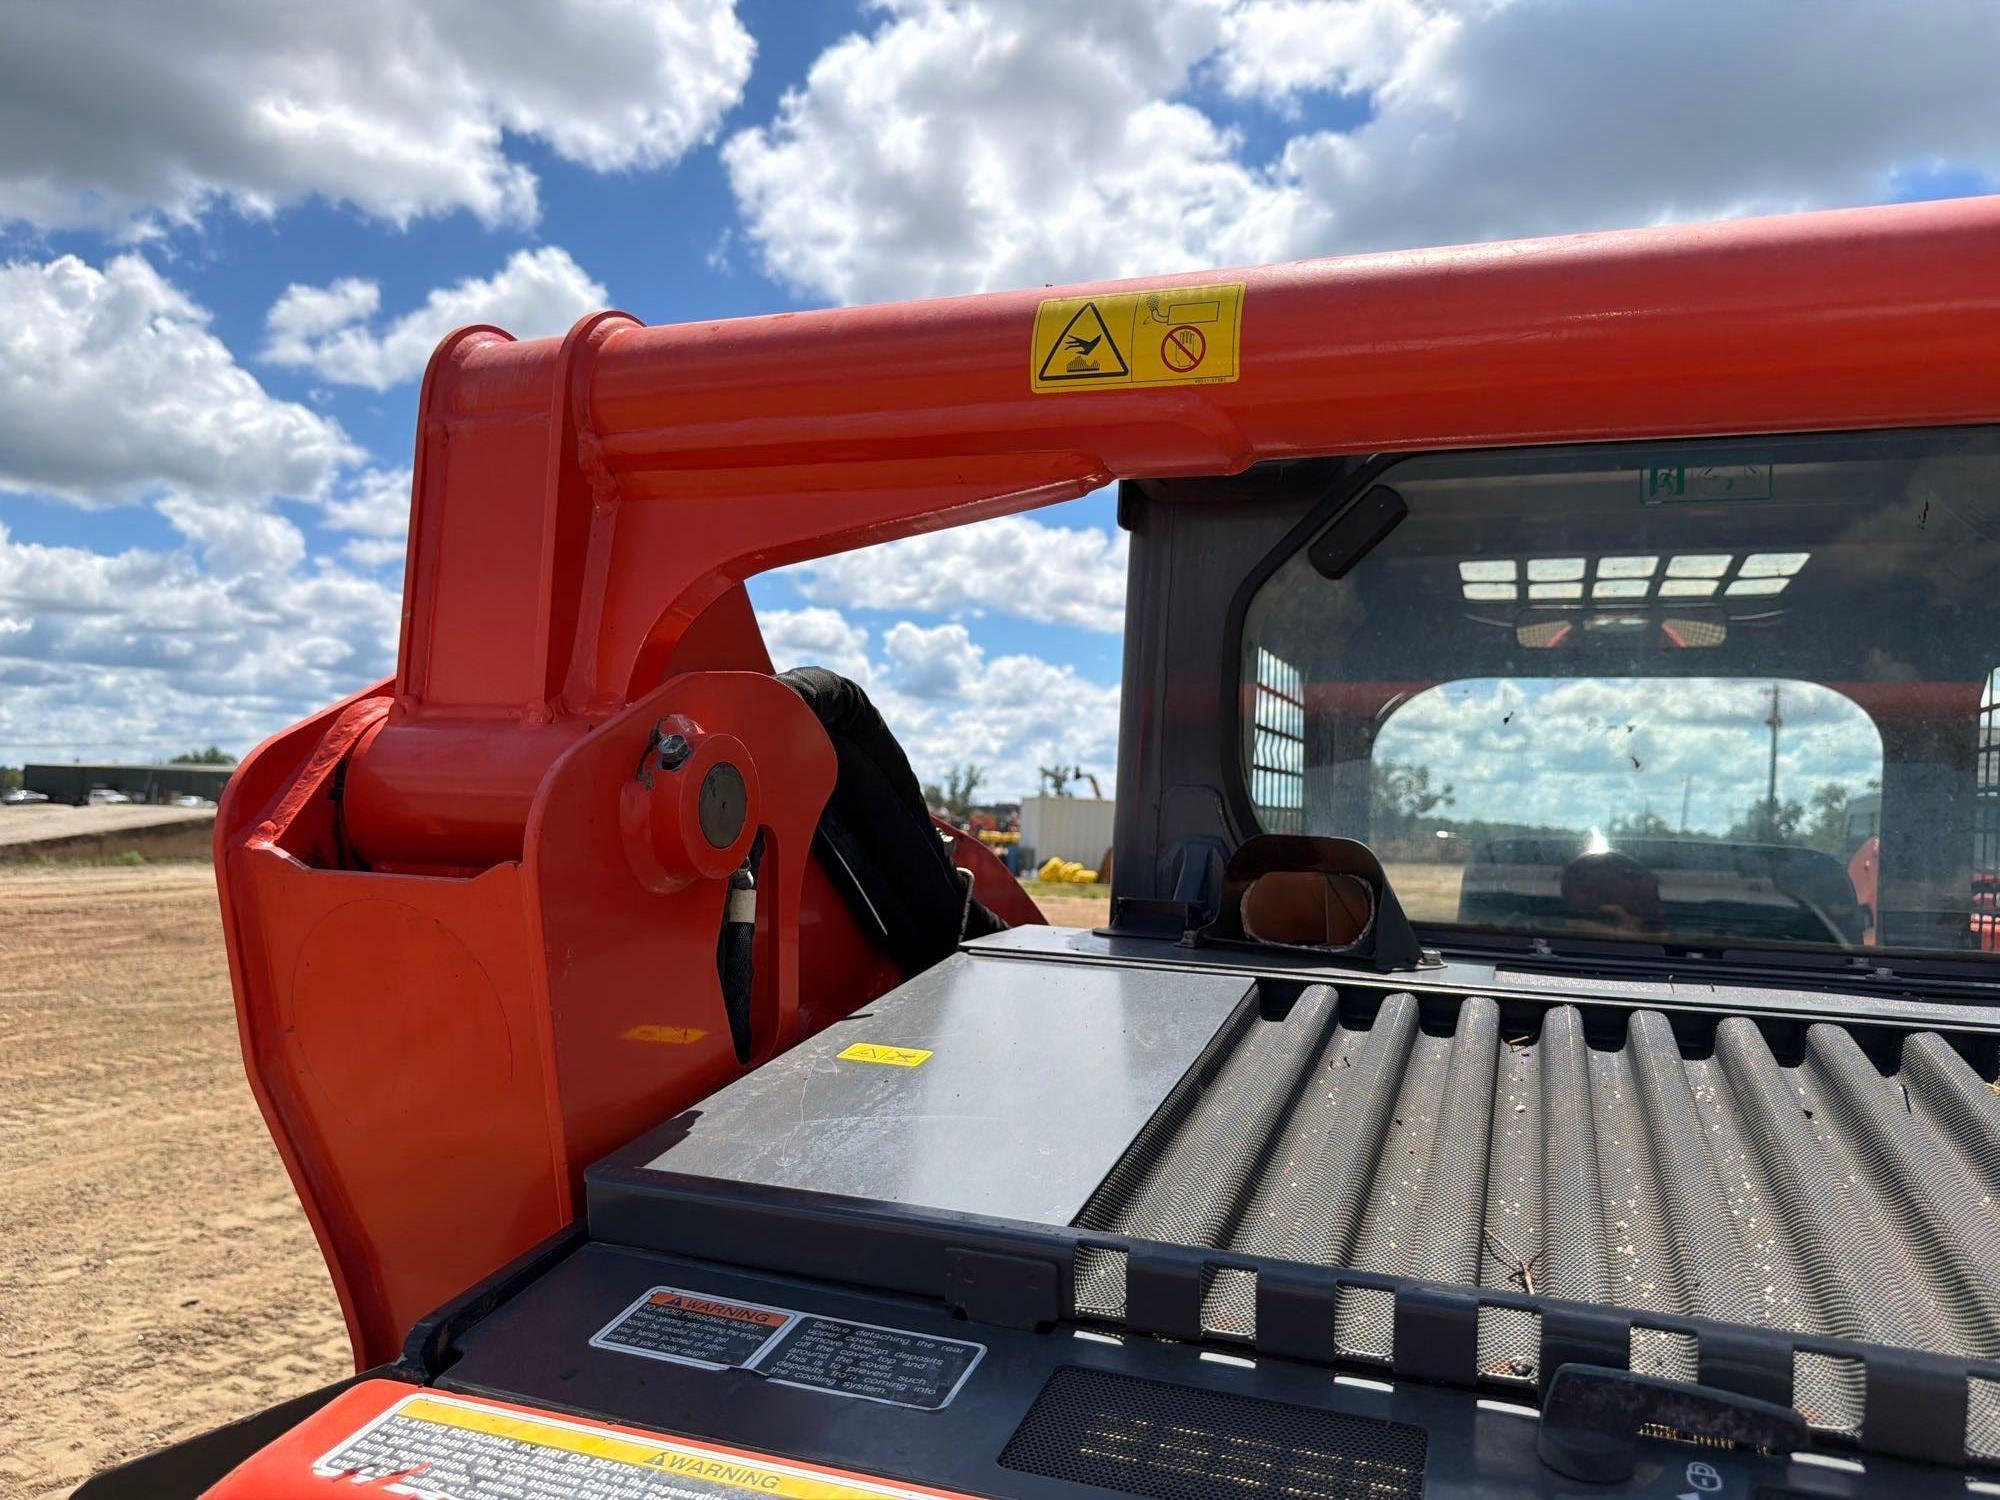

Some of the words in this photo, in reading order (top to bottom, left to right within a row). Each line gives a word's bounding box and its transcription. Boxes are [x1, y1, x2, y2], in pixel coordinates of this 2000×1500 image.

[682, 1311, 728, 1326] PERSONAL
[686, 1300, 769, 1323] WARNING
[806, 1328, 841, 1339] upper
[812, 1321, 850, 1334] Before
[855, 1329, 911, 1346] detaching
[916, 1339, 936, 1349] the
[940, 1344, 967, 1354] rear
[788, 1347, 831, 1360] around
[834, 1354, 854, 1364] the
[794, 1340, 814, 1348] off
[815, 1343, 834, 1353] the
[839, 1349, 873, 1360] cover
[878, 1355, 897, 1365] top
[902, 1360, 927, 1370] and
[800, 1335, 844, 1347] remove
[848, 1342, 889, 1356] foreign
[894, 1350, 945, 1366] deposits
[768, 1366, 790, 1376] the
[794, 1372, 837, 1386] cooling
[841, 1380, 887, 1394] system.
[775, 1360, 825, 1375] deposits
[830, 1369, 857, 1381] from
[863, 1377, 908, 1391] coming
[913, 1387, 937, 1395] into
[784, 1352, 808, 1364] This
[812, 1359, 824, 1367] is
[828, 1362, 842, 1370] to
[845, 1366, 892, 1380] prevent
[897, 1375, 927, 1386] such
[366, 1432, 388, 1444] the
[386, 1435, 415, 1446] DPF
[411, 1441, 454, 1457] muffler
[451, 1451, 477, 1462] and
[476, 1455, 498, 1467] the
[498, 1459, 582, 1486] SCR(Selective
[378, 1423, 410, 1436] When
[409, 1429, 431, 1441] the
[431, 1432, 469, 1449] Diesel
[468, 1441, 531, 1463] Particulate
[530, 1455, 598, 1477] Filter(DPF)
[597, 1469, 610, 1481] is
[610, 1472, 626, 1483] in
[626, 1476, 649, 1489] the
[390, 1415, 410, 1427] TO
[407, 1418, 449, 1434] AVOID
[447, 1425, 517, 1450] PERSONAL
[517, 1442, 568, 1460] INJURY
[567, 1453, 591, 1465] OR
[589, 1457, 642, 1476] DEATH:
[329, 1458, 358, 1468] and
[403, 1475, 446, 1490] muffler
[343, 1448, 375, 1463] away
[371, 1454, 401, 1467] from
[427, 1469, 471, 1486] people,
[476, 1479, 525, 1498] animals,
[355, 1439, 396, 1456] During
[394, 1449, 468, 1473] regeneration,
[473, 1466, 501, 1479] take
[500, 1472, 527, 1485] into
[526, 1479, 578, 1496] account
[577, 1489, 606, 1500] that
[668, 1454, 781, 1490] WARNING
